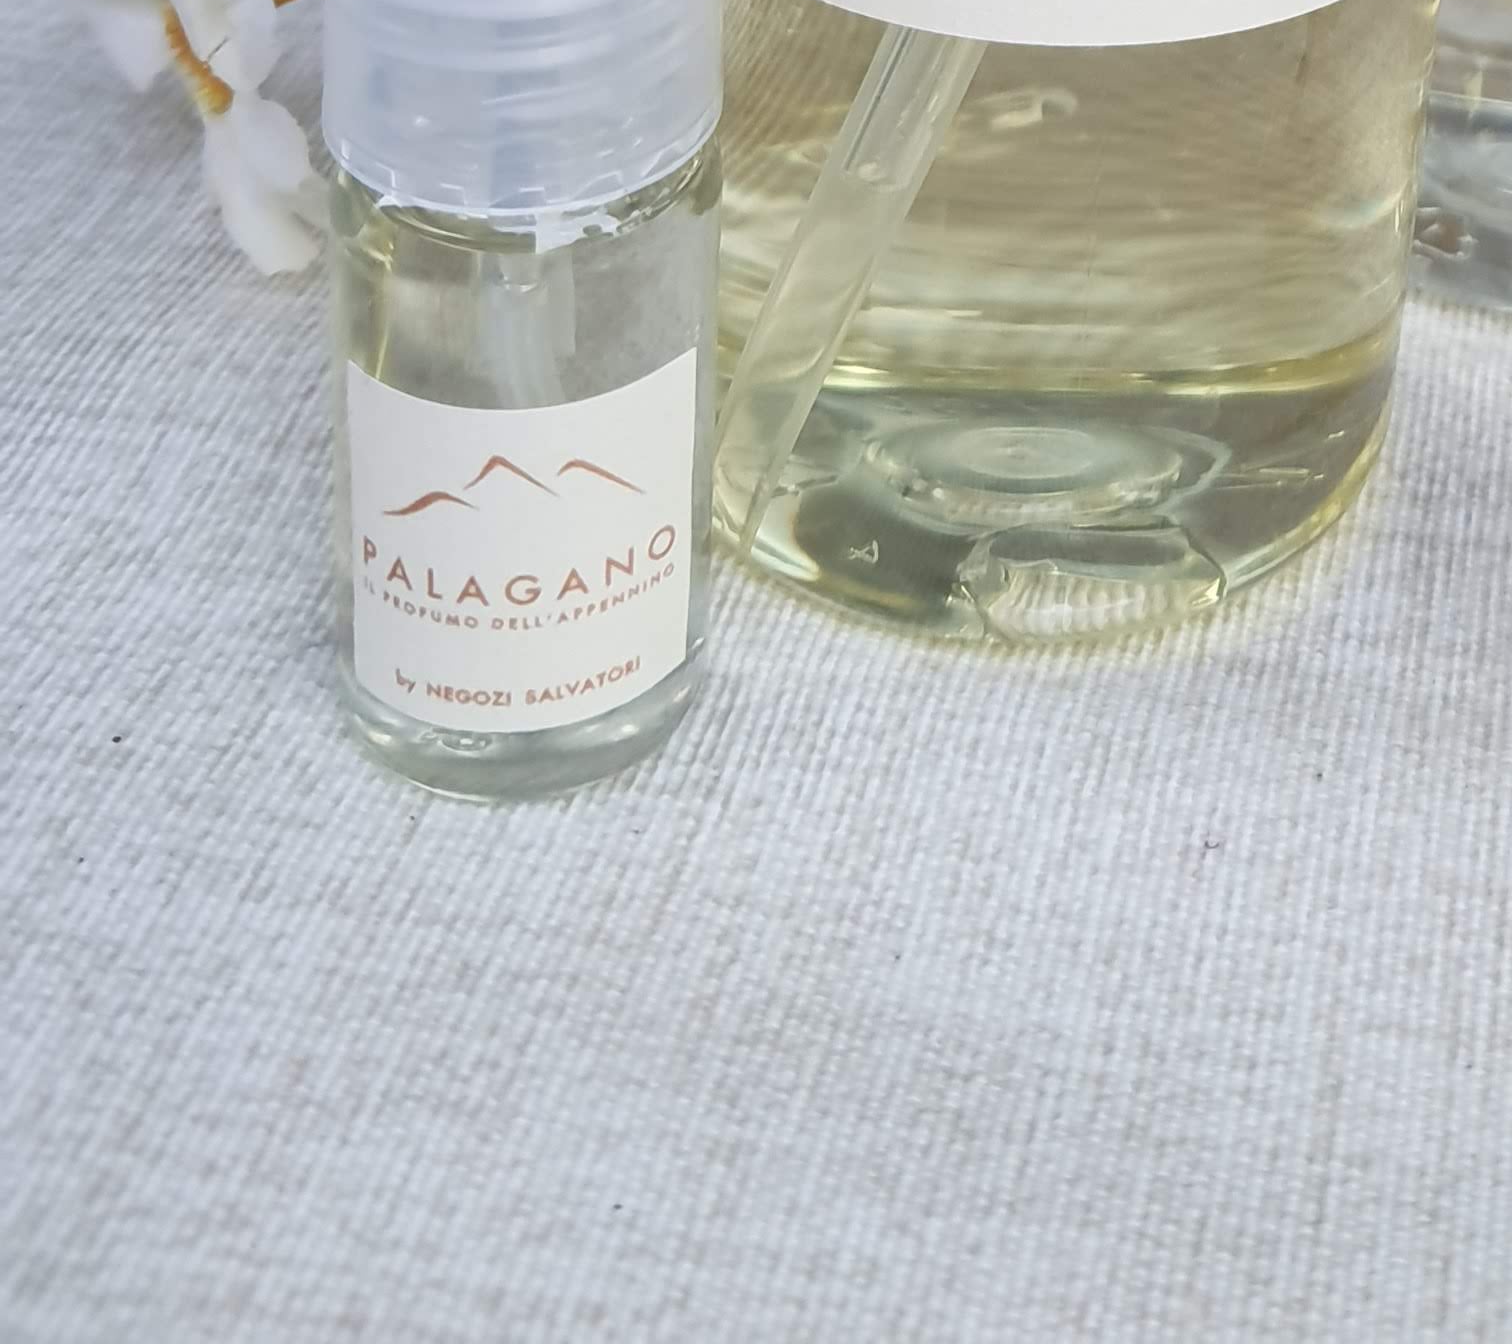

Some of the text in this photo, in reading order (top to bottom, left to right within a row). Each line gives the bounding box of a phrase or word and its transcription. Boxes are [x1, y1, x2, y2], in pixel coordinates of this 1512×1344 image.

[364, 525, 675, 606] PALAGANO
[383, 590, 478, 629] PROFUMO
[491, 562, 674, 630] DELL'APPENNINO
[396, 656, 640, 706] by NEGOZI SALVATORI
